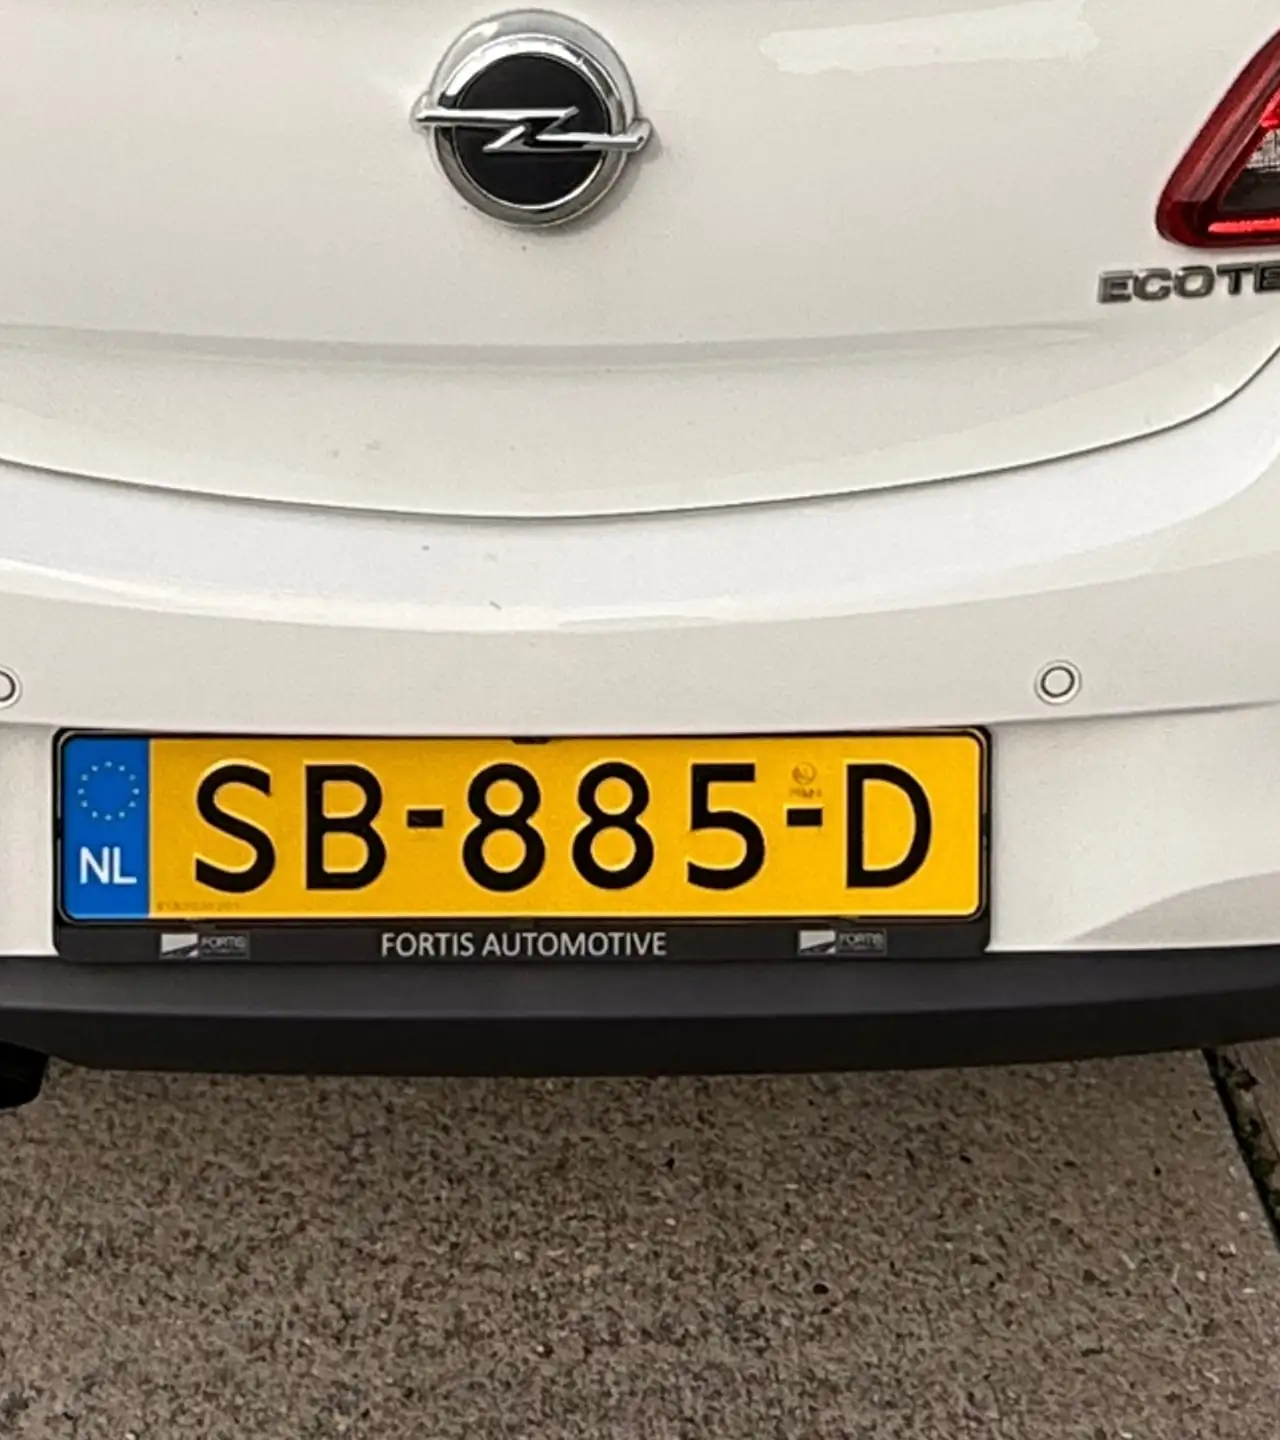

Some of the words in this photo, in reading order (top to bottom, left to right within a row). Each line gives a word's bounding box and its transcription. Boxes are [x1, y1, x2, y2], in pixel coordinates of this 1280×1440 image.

[192, 761, 933, 893] SB-885-D
[79, 846, 137, 885] NL
[381, 932, 475, 957] FORTIS
[482, 931, 667, 957] AUTOMOTIVE
